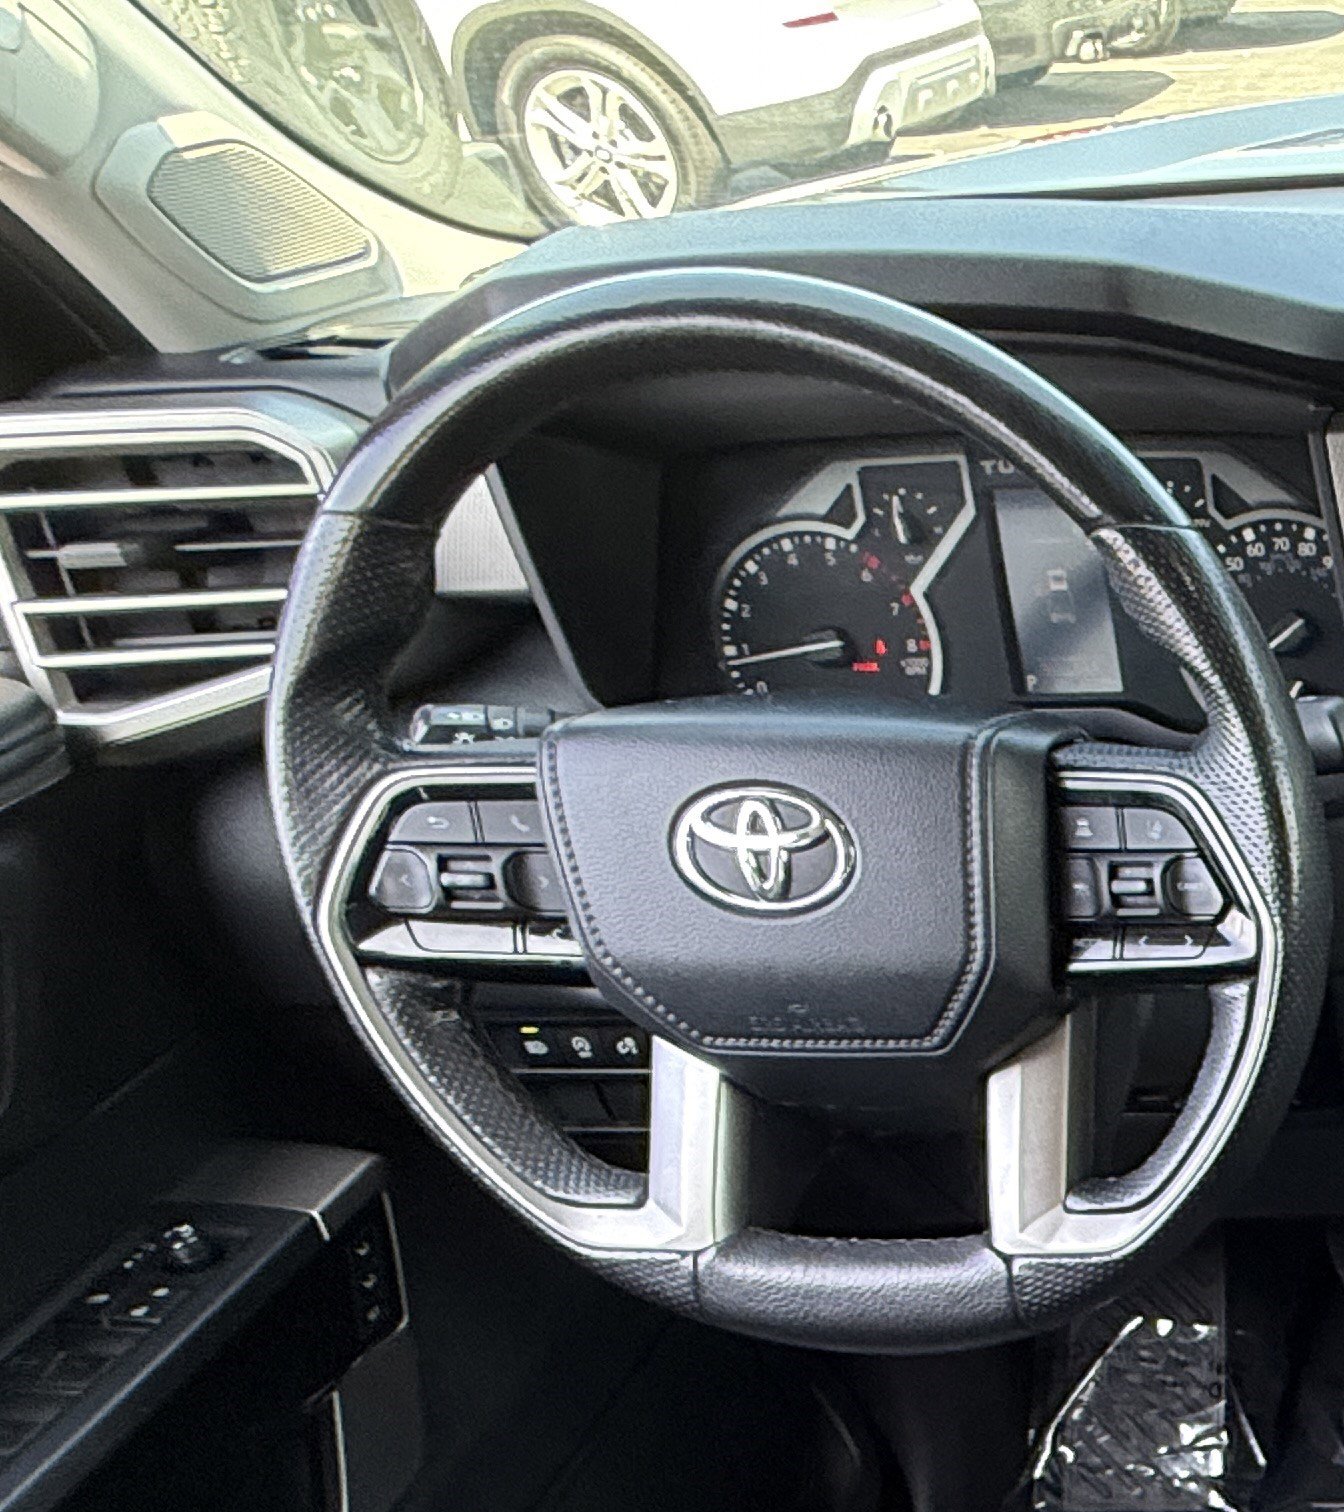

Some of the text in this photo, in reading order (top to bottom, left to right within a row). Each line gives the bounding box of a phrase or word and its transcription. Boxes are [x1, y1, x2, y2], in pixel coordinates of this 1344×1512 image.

[1246, 543, 1266, 558] 60
[1272, 536, 1291, 551] 70
[1297, 542, 1318, 557] 80
[1225, 556, 1245, 572] 50
